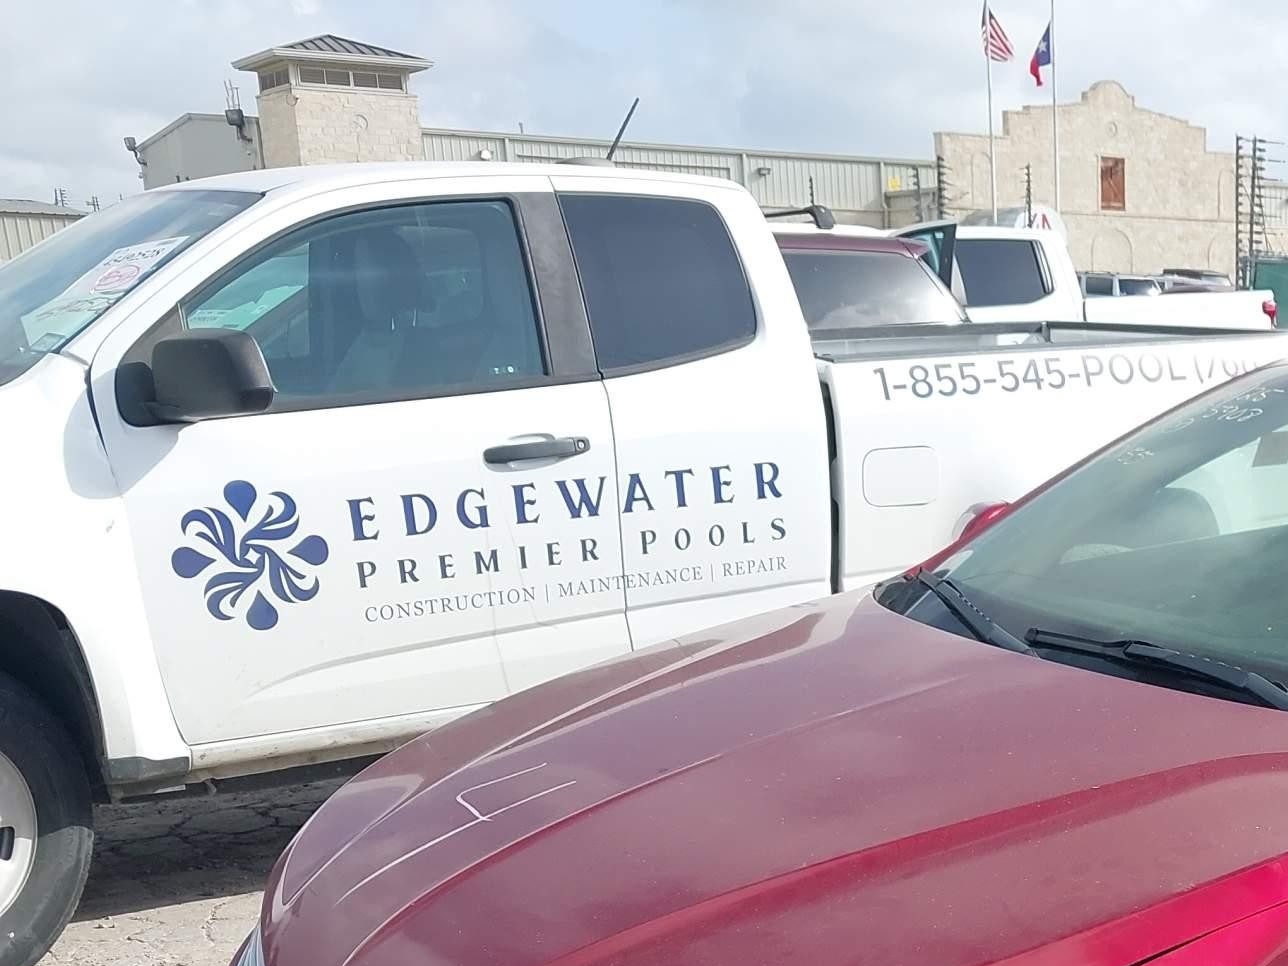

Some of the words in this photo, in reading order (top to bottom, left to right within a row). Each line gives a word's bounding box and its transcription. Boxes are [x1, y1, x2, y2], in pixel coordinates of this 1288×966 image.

[872, 354, 1187, 401] 1-855-545-POOL
[345, 461, 784, 542] EDGEWATER
[355, 537, 601, 589] PREMIER
[639, 517, 788, 556] POOLS
[364, 585, 538, 623] CONSTRUCTION
[557, 565, 705, 599] MAINTENANCE
[721, 555, 789, 578] REPAIR
